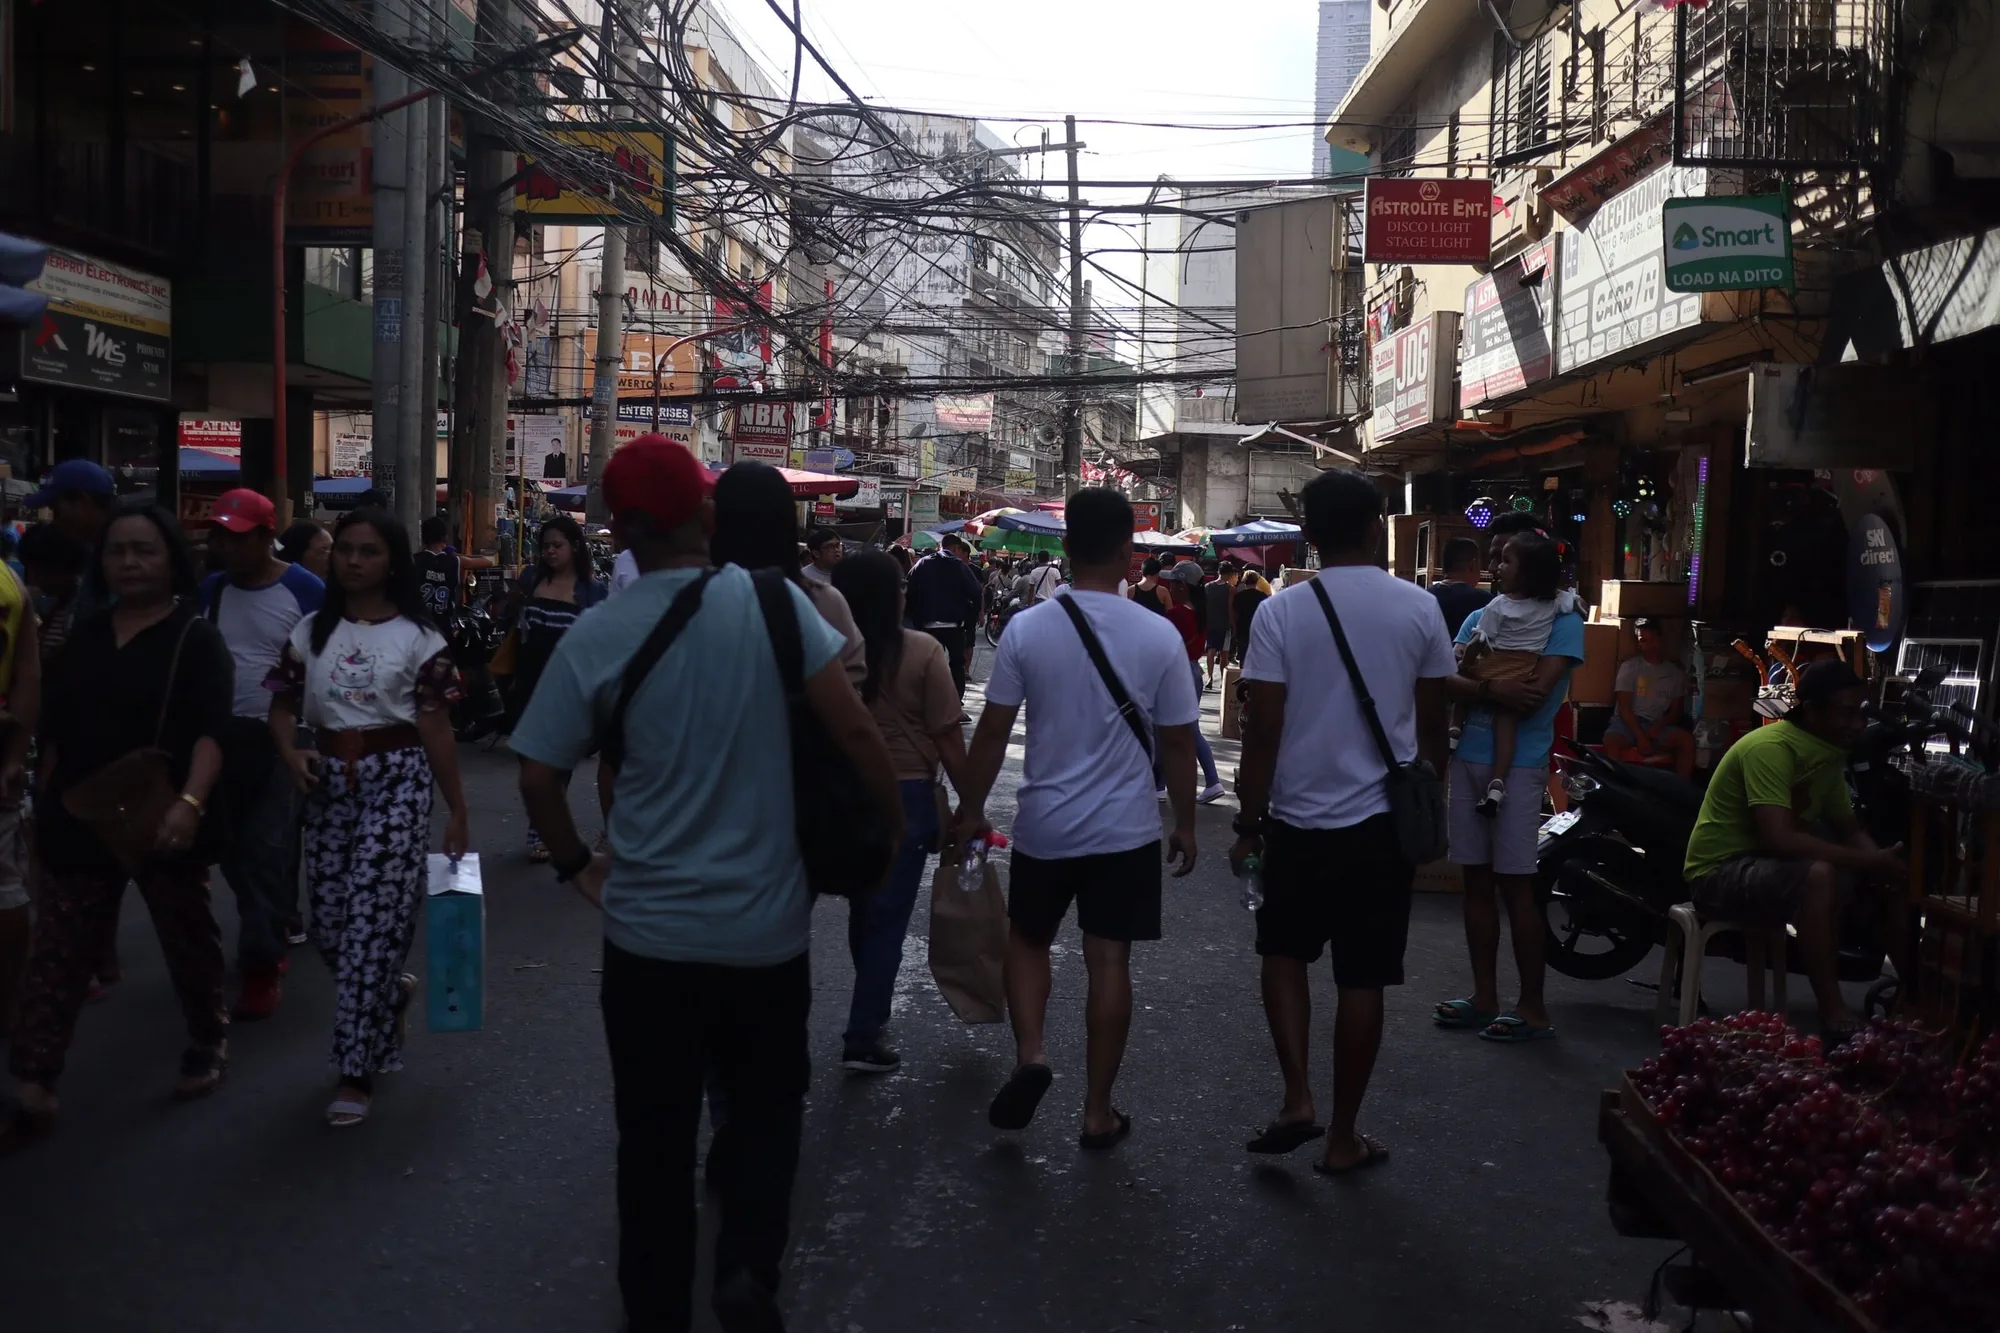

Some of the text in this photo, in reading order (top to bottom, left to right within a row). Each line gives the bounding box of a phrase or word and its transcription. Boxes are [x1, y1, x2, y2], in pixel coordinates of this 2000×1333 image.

[1371, 196, 1488, 218] ASTROLITE ENT.
[1595, 170, 1676, 241] ELECTRONICS
[1387, 221, 1471, 233] DISCO LIGHT
[1386, 236, 1472, 248] STAGE LIGHT
[1701, 223, 1775, 249] Smart
[86, 263, 150, 294] ELECTRONICS
[151, 284, 169, 299] INC.
[1674, 268, 1783, 286] LOAD NA DITO
[1396, 325, 1429, 391] JDG
[142, 361, 160, 375] STAR
[619, 403, 689, 420] ENTERRISES
[739, 403, 788, 428] NBK
[184, 420, 241, 431] PLATINU
[739, 426, 787, 435] ENTERPRISES
[742, 446, 784, 455] PLATINUM
[880, 488, 903, 501] onus
[1248, 533, 1297, 541] MICROMATIC
[1866, 529, 1886, 548] SKY
[1860, 550, 1896, 567] direct
